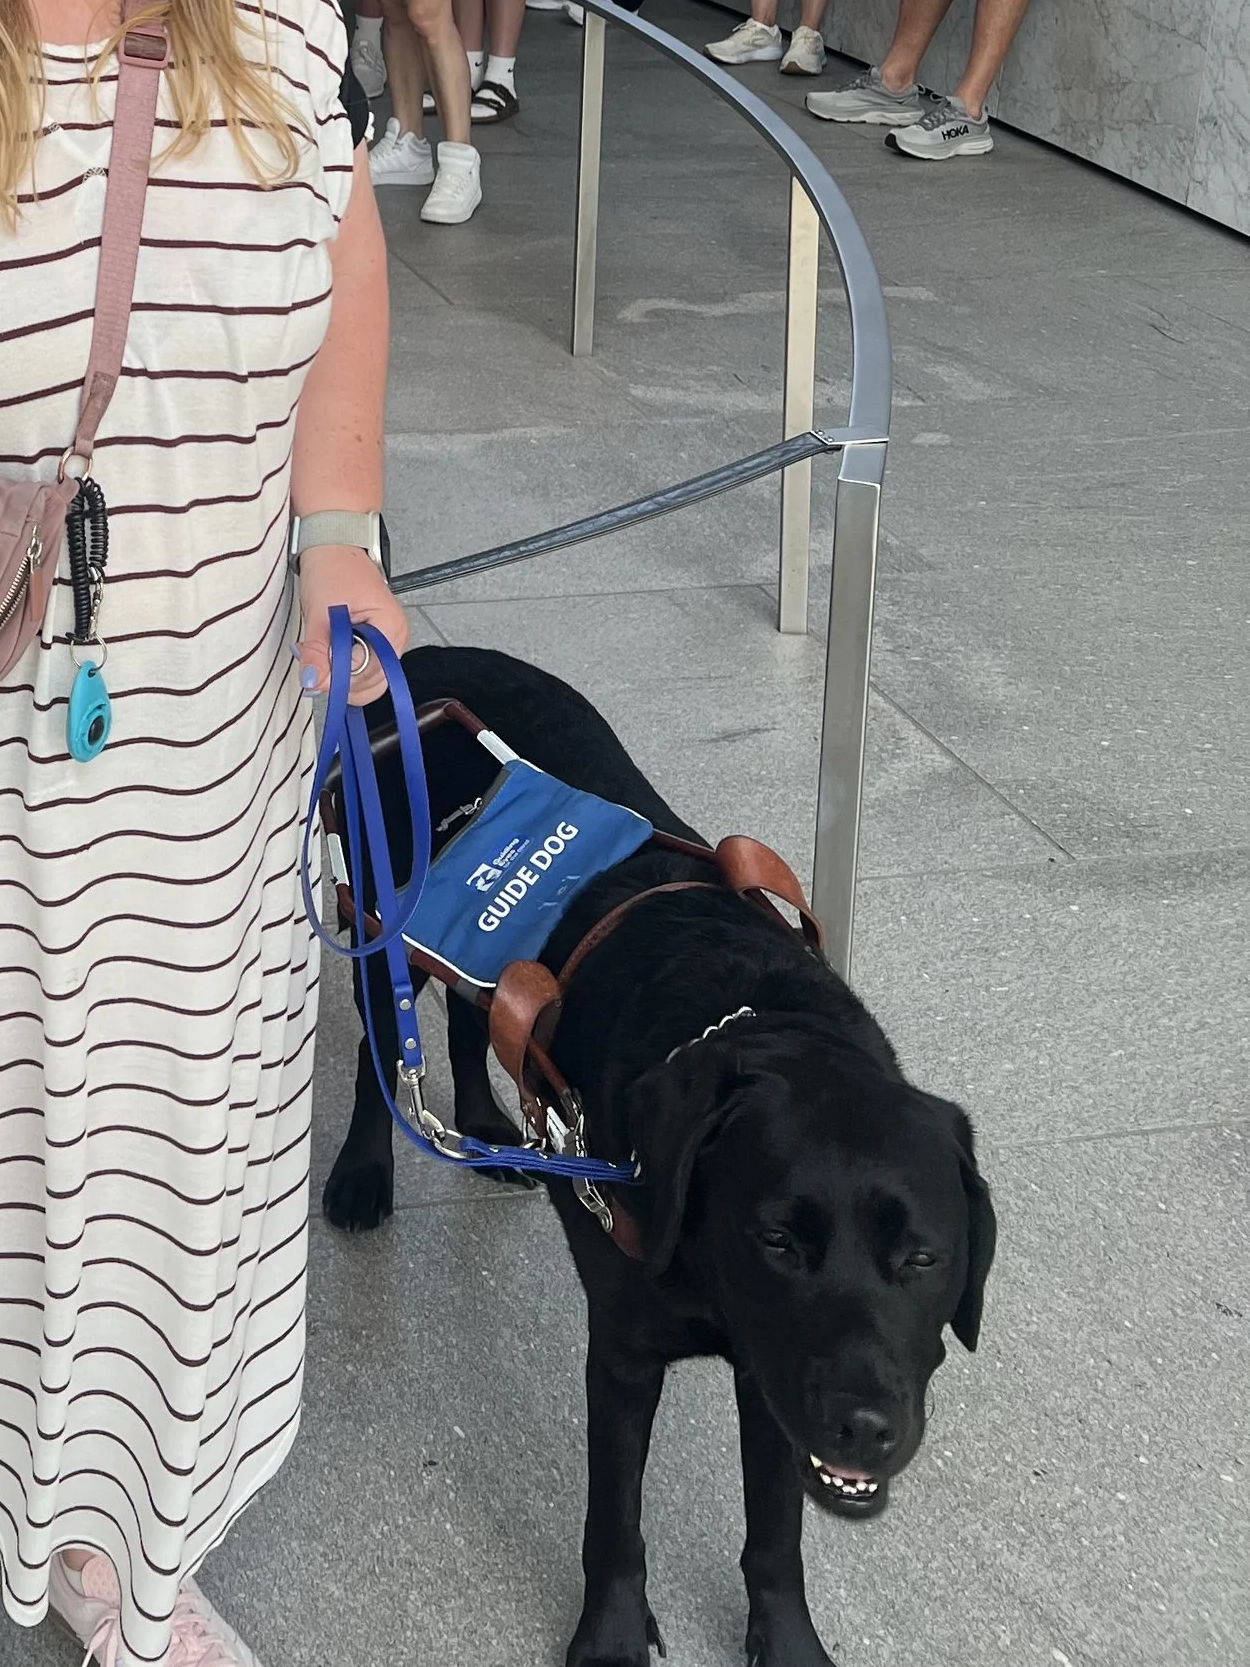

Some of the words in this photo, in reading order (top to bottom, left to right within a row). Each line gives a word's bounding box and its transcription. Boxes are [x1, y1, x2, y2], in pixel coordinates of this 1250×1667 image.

[941, 124, 970, 141] HOKA
[478, 866, 540, 932] GUIDE
[529, 821, 579, 871] DOG
